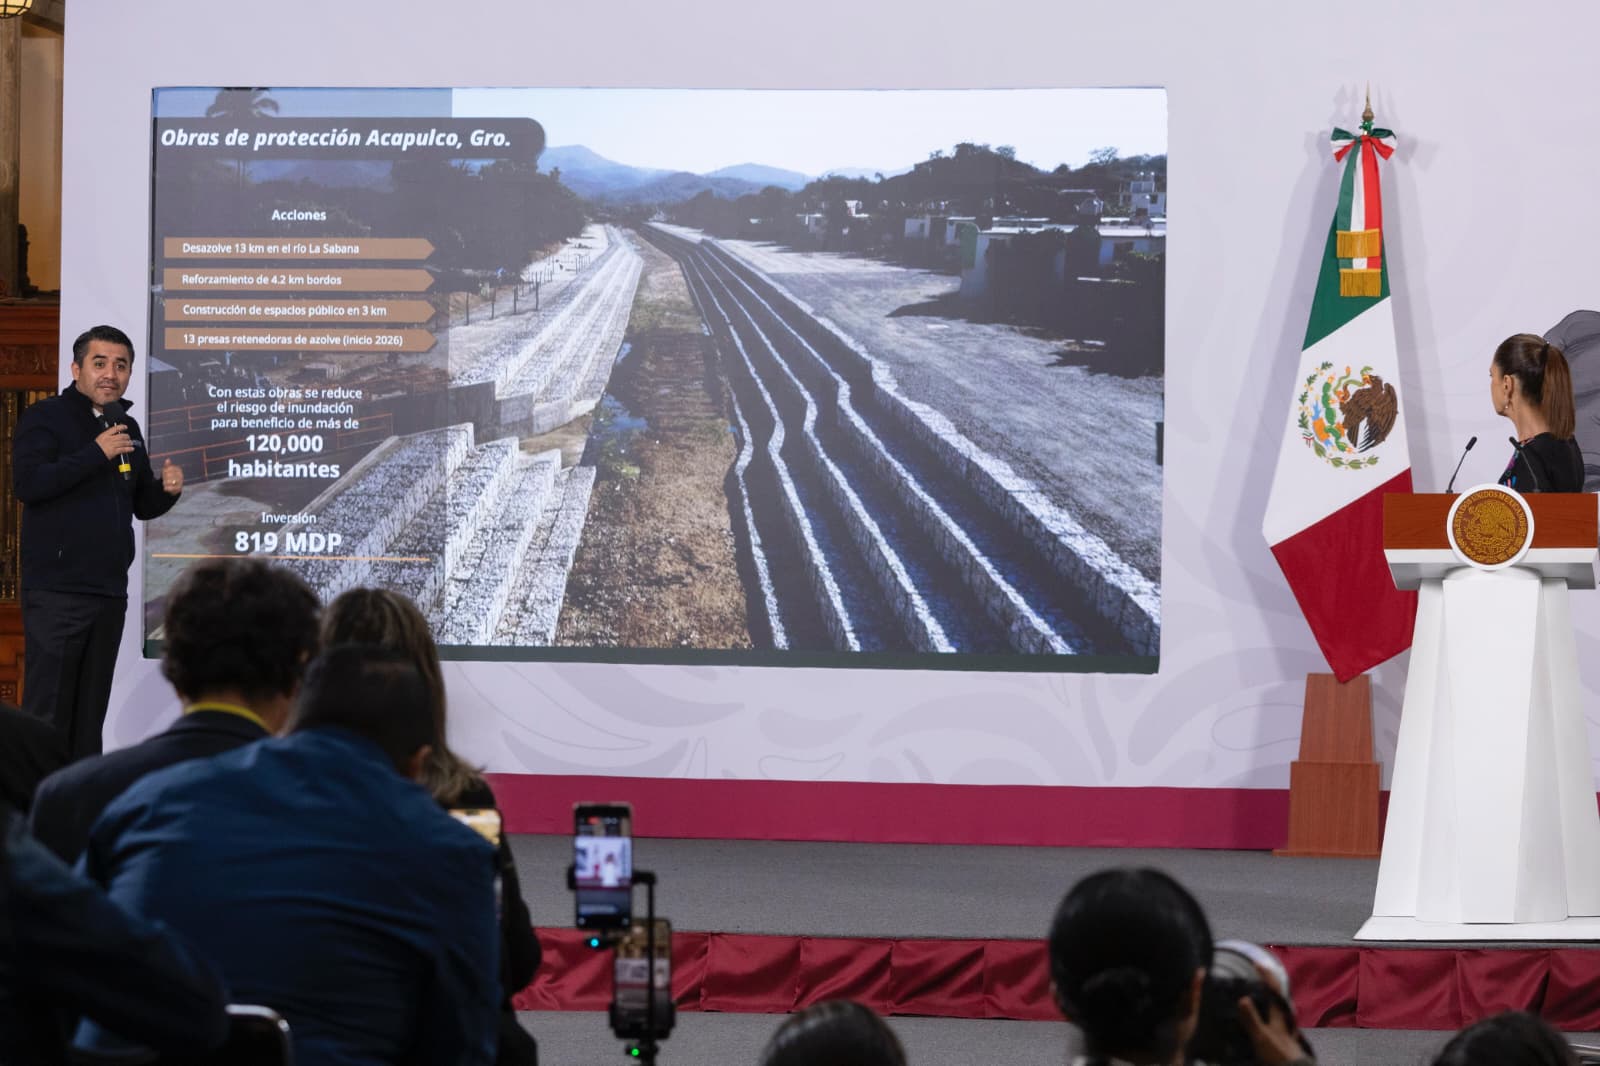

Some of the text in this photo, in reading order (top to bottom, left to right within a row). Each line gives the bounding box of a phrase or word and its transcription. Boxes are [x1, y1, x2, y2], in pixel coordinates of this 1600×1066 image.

[161, 128, 511, 151] Obras de protección Acapulco, Gro.
[271, 209, 327, 221] Acciones
[182, 243, 232, 253] Desazolve
[235, 243, 246, 253] 13
[249, 243, 264, 253] km
[282, 244, 291, 253] el
[293, 244, 306, 253] río
[309, 244, 320, 253] La
[323, 244, 359, 254] Sabana
[182, 274, 342, 285] Reforzamiento de 4.2 km bordos
[183, 304, 246, 315] Construcción
[249, 305, 261, 315] de
[264, 305, 306, 317] espacios
[308, 305, 345, 317] público
[362, 306, 369, 315] 3
[371, 306, 387, 315] km
[184, 334, 403, 347] 13 presas retenedoras de azolve (inicio 2026)
[209, 387, 362, 398] Con estas obras se reduce
[217, 402, 352, 416] el riesgo de inundación
[212, 418, 359, 430] para beneficio de más de
[246, 436, 322, 454] 120,000
[229, 460, 340, 478] habitantes
[262, 512, 316, 524] Inversión
[236, 532, 341, 552] 819 MDP
